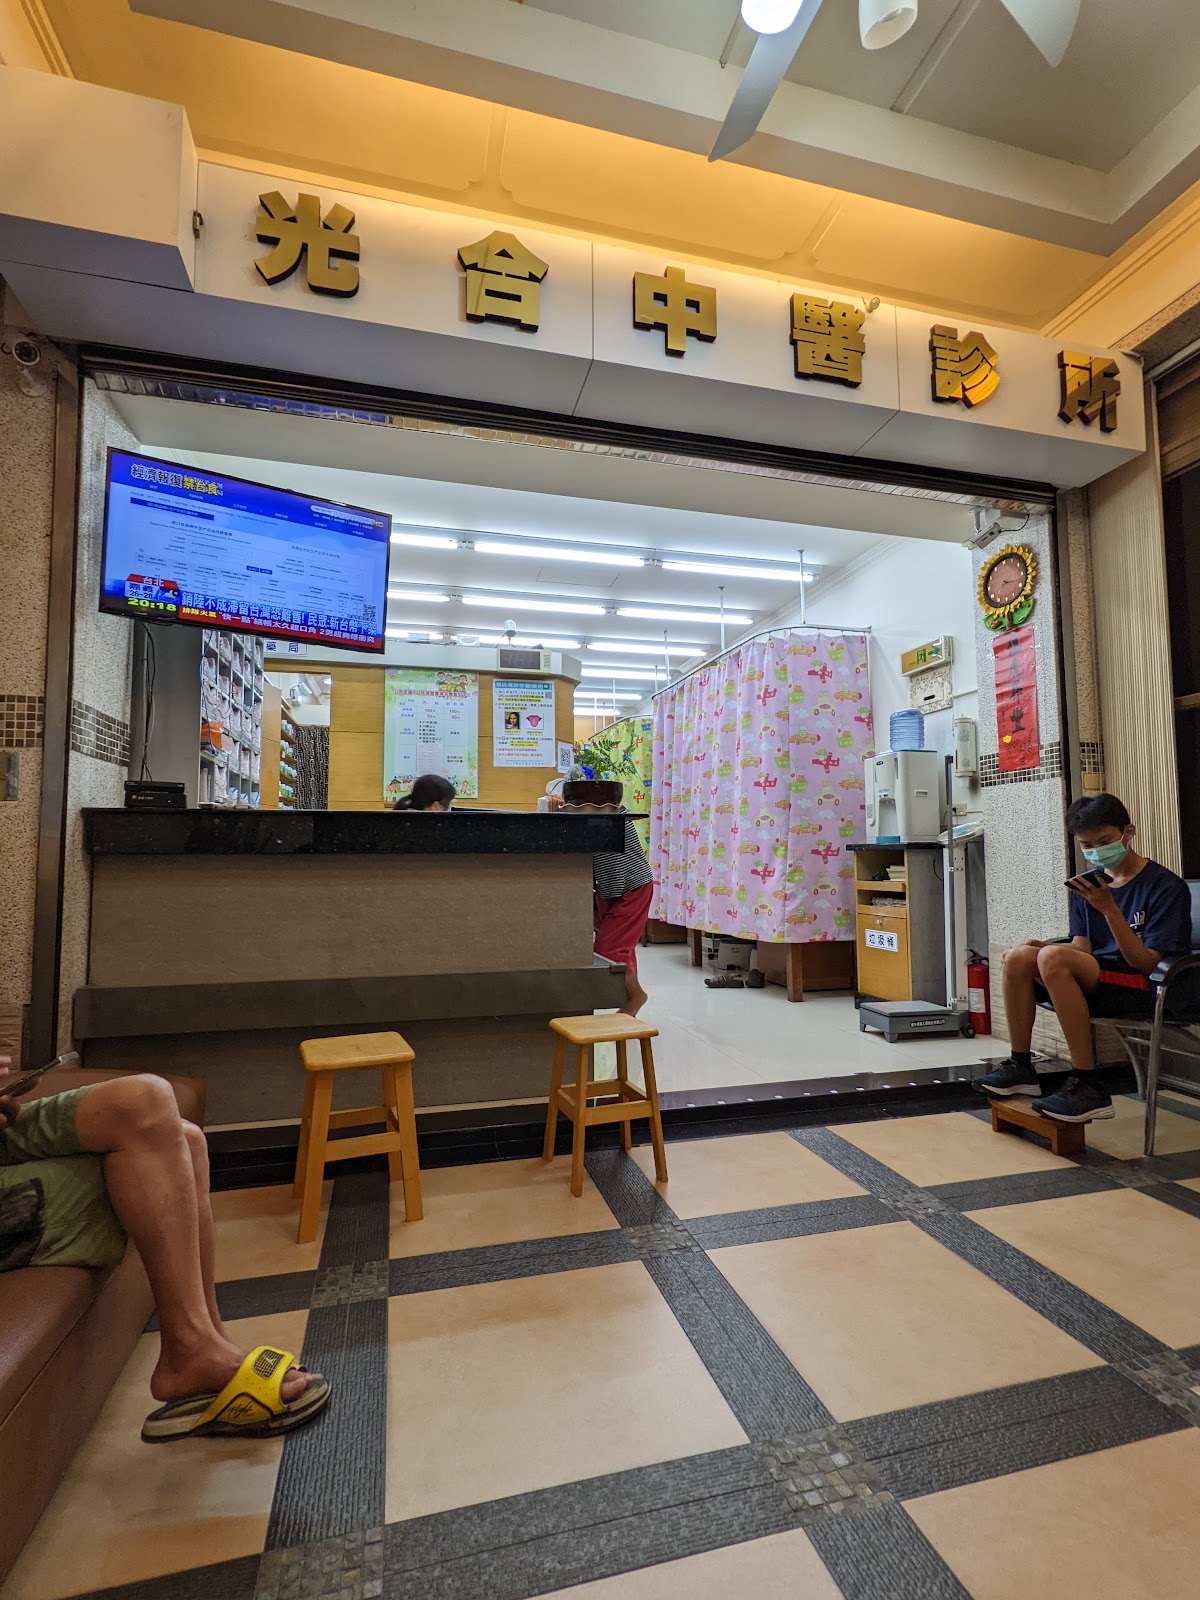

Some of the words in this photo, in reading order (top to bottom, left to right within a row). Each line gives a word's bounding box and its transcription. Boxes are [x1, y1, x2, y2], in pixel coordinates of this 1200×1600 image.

[254, 191, 1120, 433] 光合中醫診所
[143, 577, 165, 587] 台北
[129, 589, 153, 599] 26-28
[127, 597, 177, 612] 20:18
[266, 641, 299, 653] 藥局
[868, 933, 894, 948] 垃圾桶
